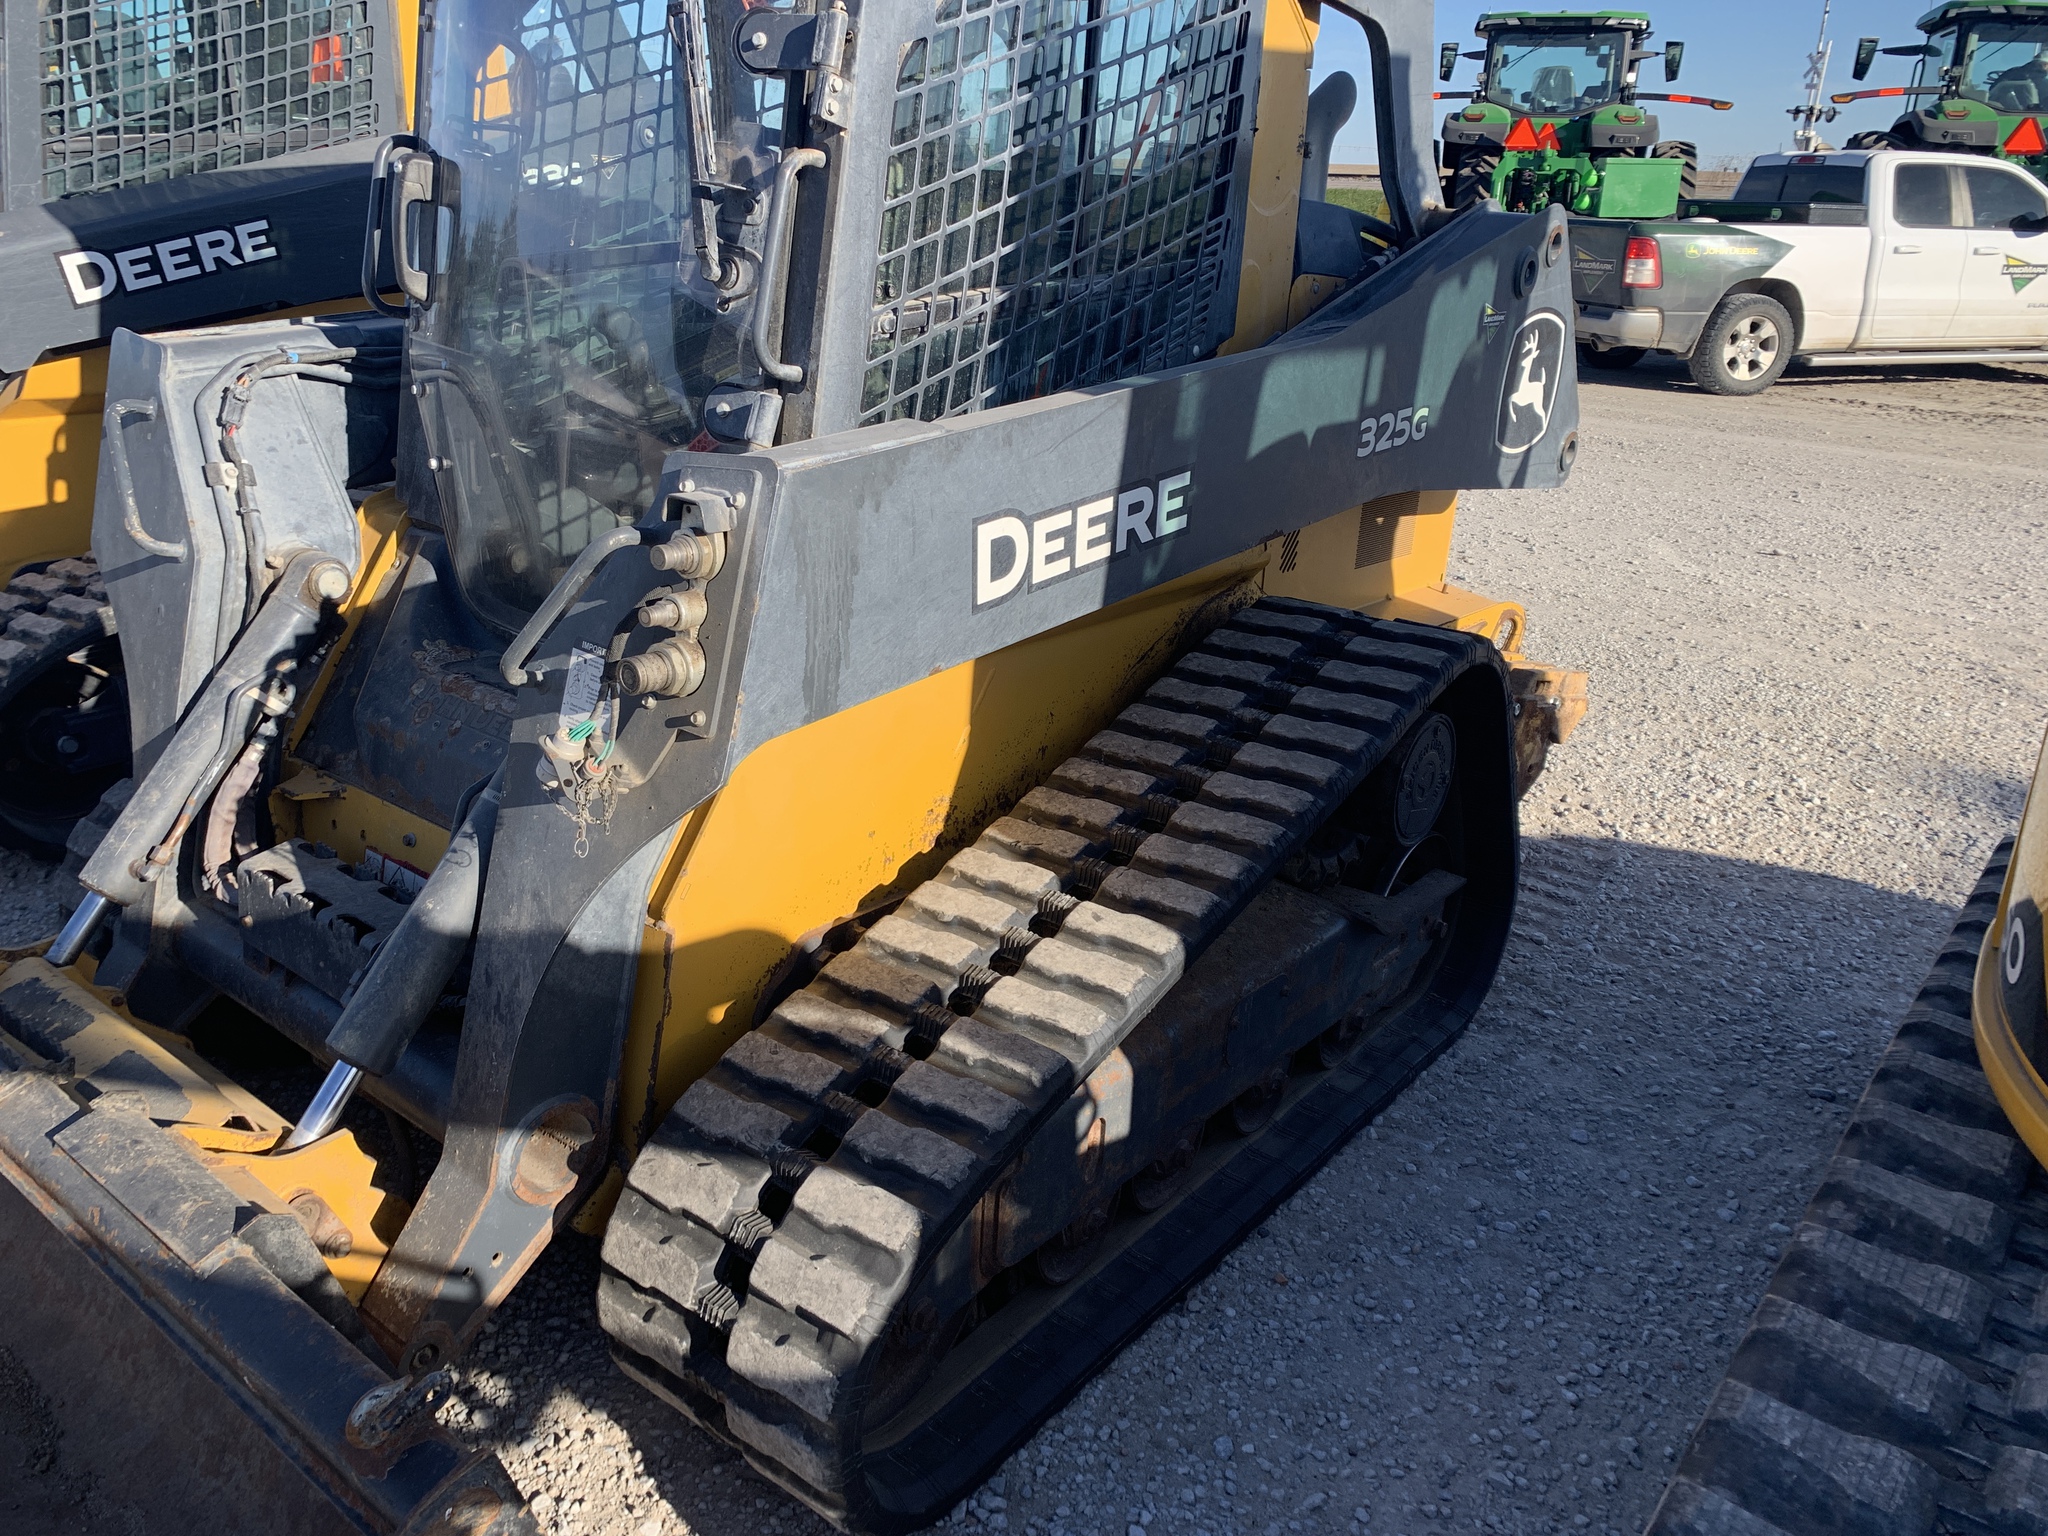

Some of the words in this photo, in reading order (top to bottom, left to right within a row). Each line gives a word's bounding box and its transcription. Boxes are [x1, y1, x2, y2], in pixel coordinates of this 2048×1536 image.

[59, 219, 278, 305] DEERE
[1728, 246, 1759, 255] DEERE
[1357, 406, 1430, 457] 325G
[976, 470, 1192, 606] DEERE
[581, 640, 607, 656] IMPORT
